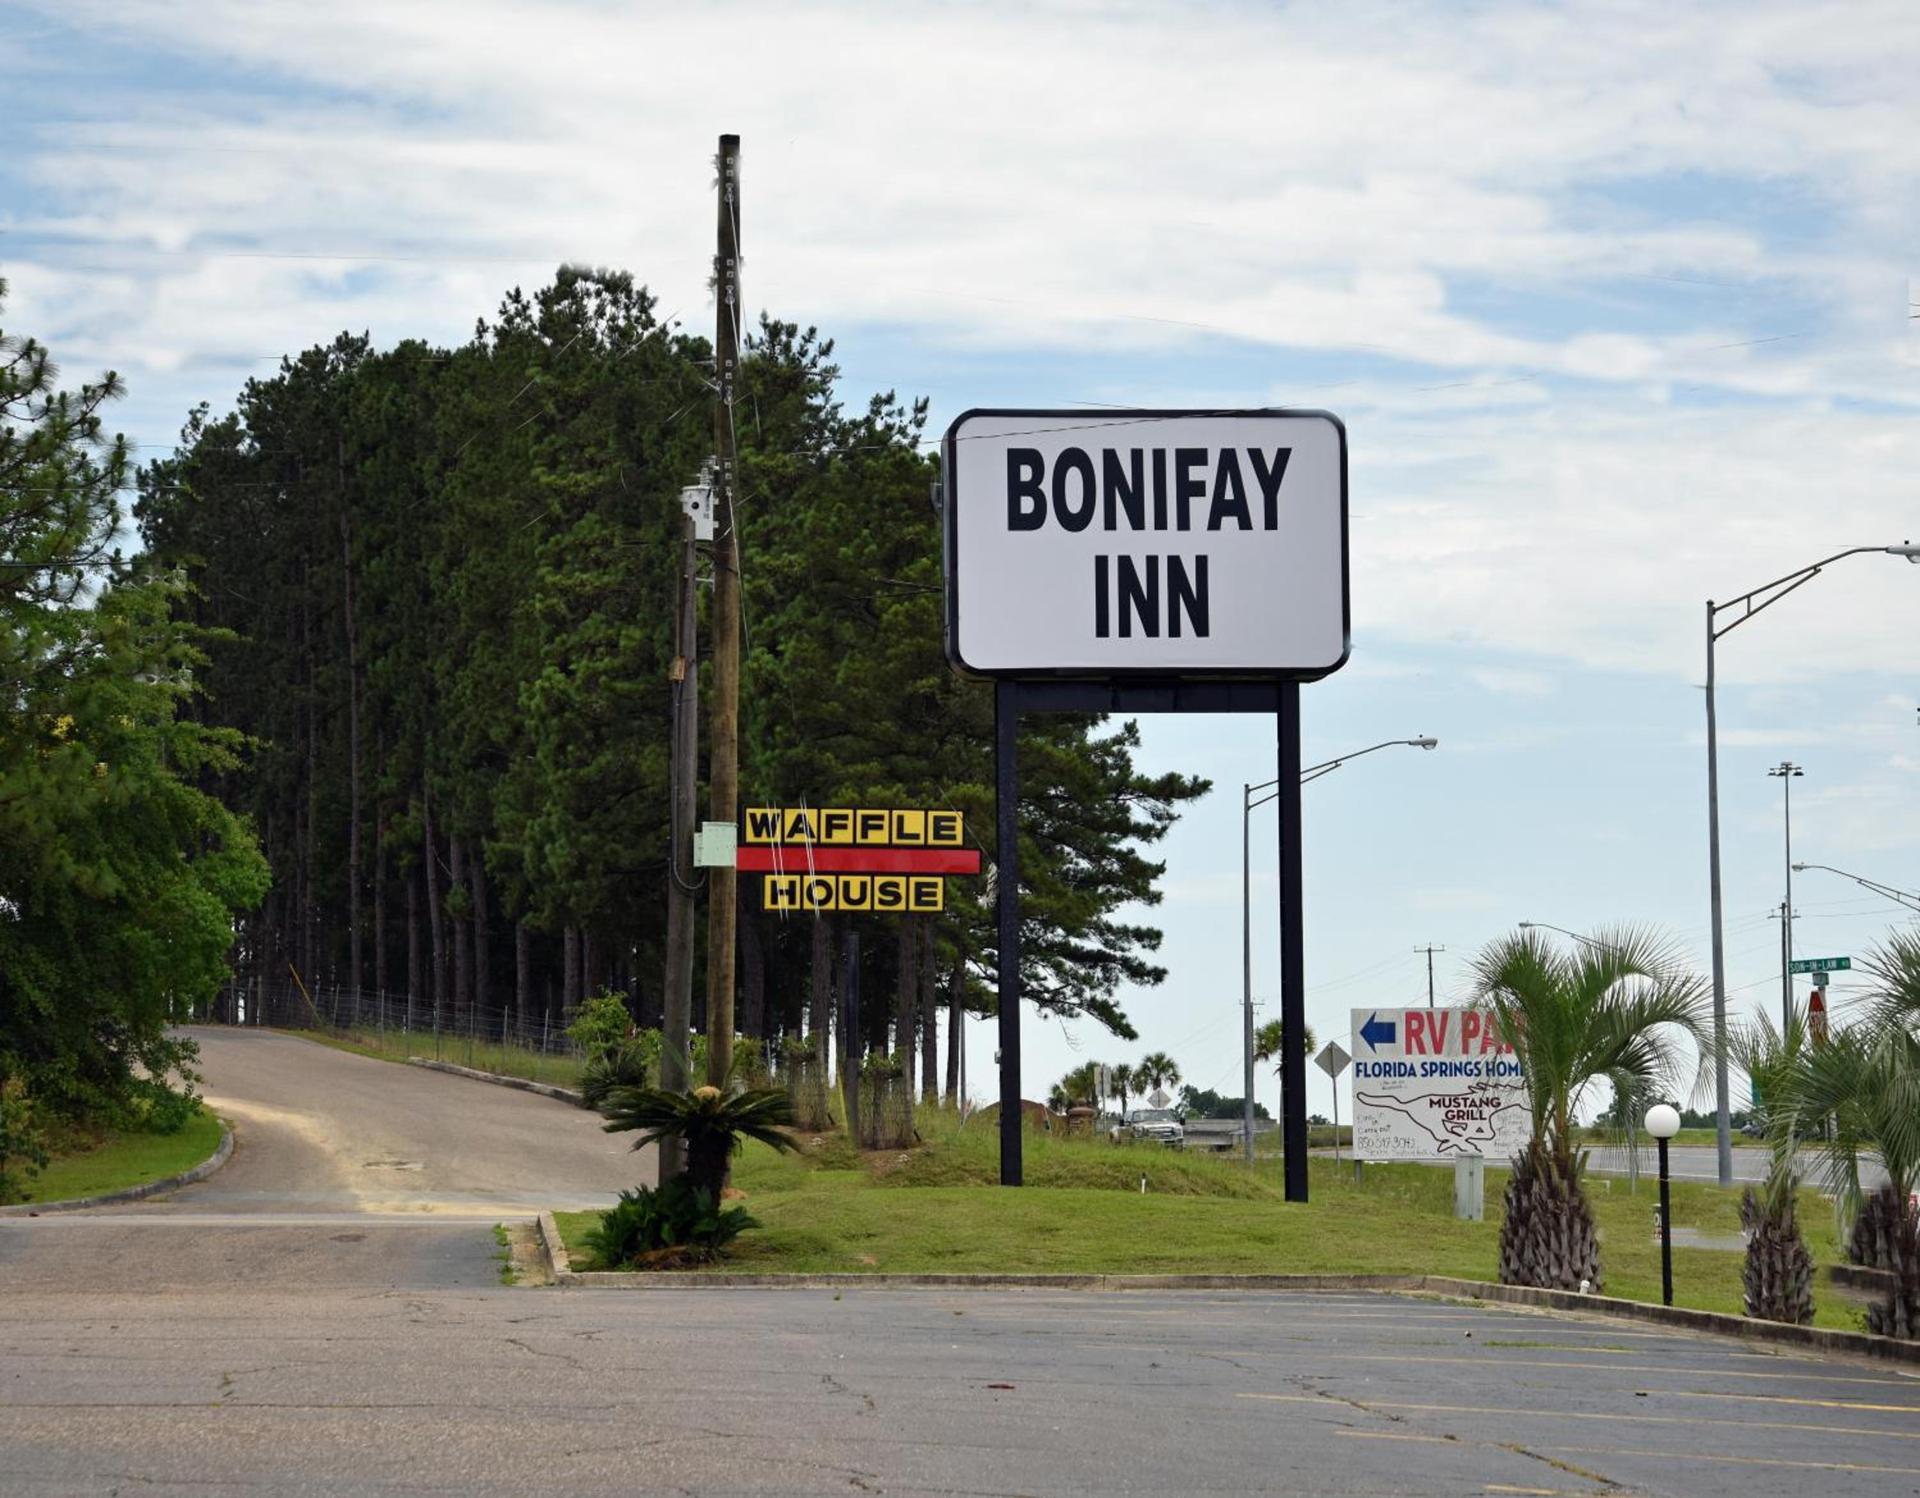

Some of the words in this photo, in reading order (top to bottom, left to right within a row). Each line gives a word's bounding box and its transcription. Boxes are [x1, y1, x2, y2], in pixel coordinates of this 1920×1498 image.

[1006, 446, 1293, 533] BONIFAY
[1094, 554, 1210, 638] INN
[748, 812, 958, 841] WAFFLE
[769, 879, 939, 907] HOUSE
[1404, 1010, 1449, 1056] RV
[1461, 1010, 1516, 1056] PA
[1355, 1062, 1418, 1079] FLORIDA
[1420, 1061, 1482, 1078] SPRINGS
[1429, 1096, 1502, 1109] MUSTANG
[1444, 1109, 1488, 1121] GRILL
